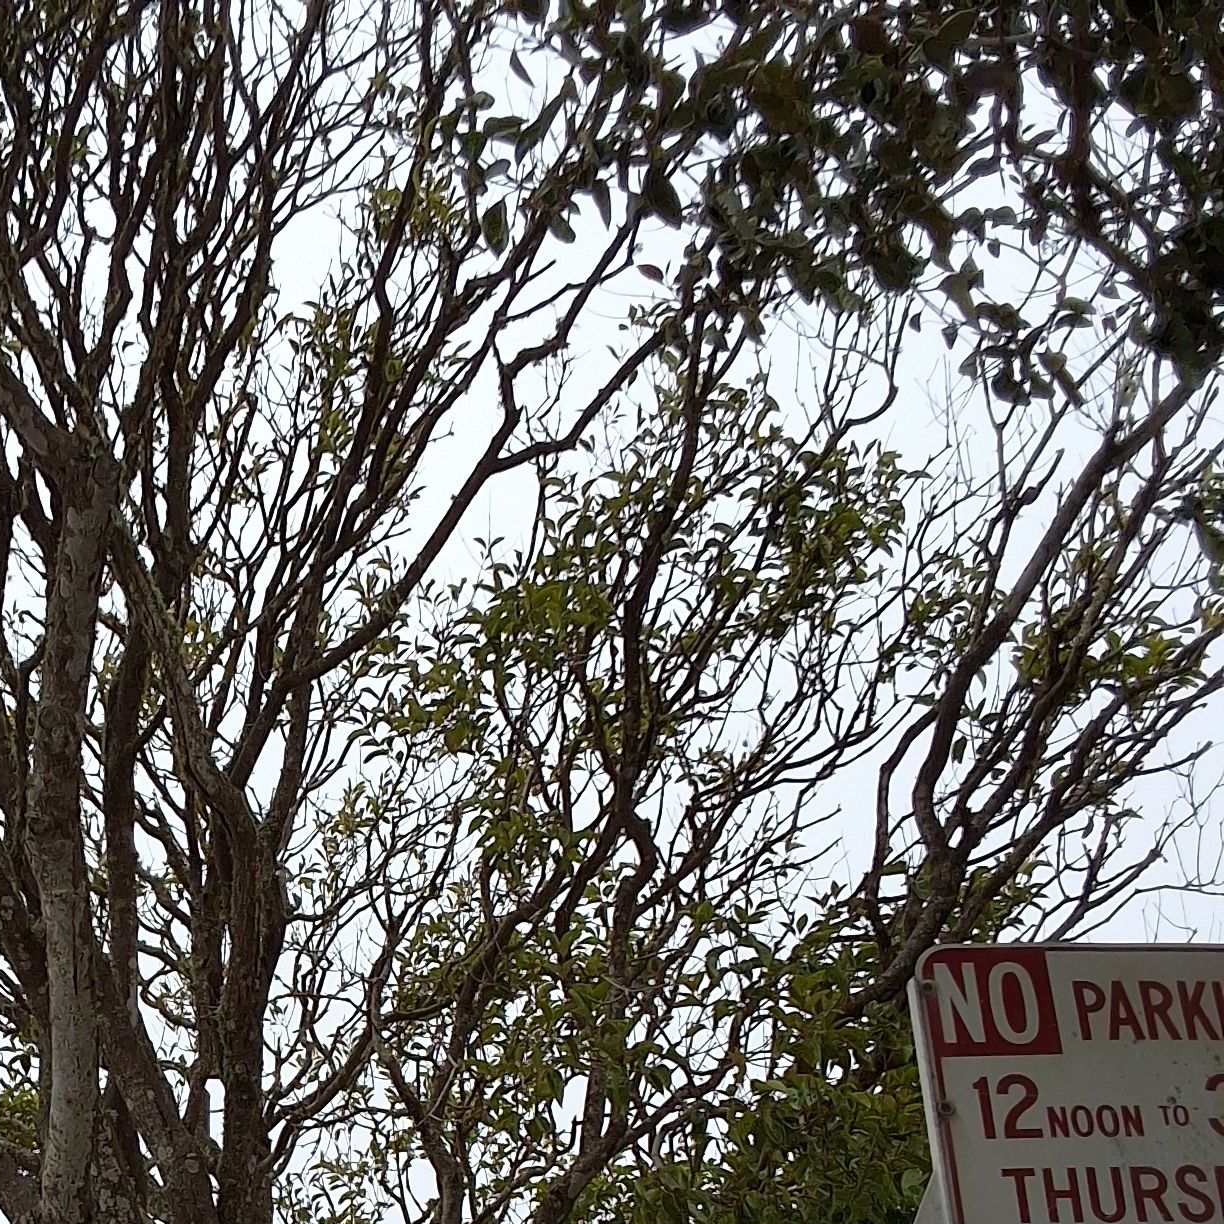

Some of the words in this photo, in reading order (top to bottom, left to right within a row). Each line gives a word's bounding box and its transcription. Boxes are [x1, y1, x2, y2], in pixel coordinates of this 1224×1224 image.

[933, 961, 1040, 1044] NO
[1158, 1105, 1190, 1126] TO
[1001, 1165, 1224, 1224] THURS
